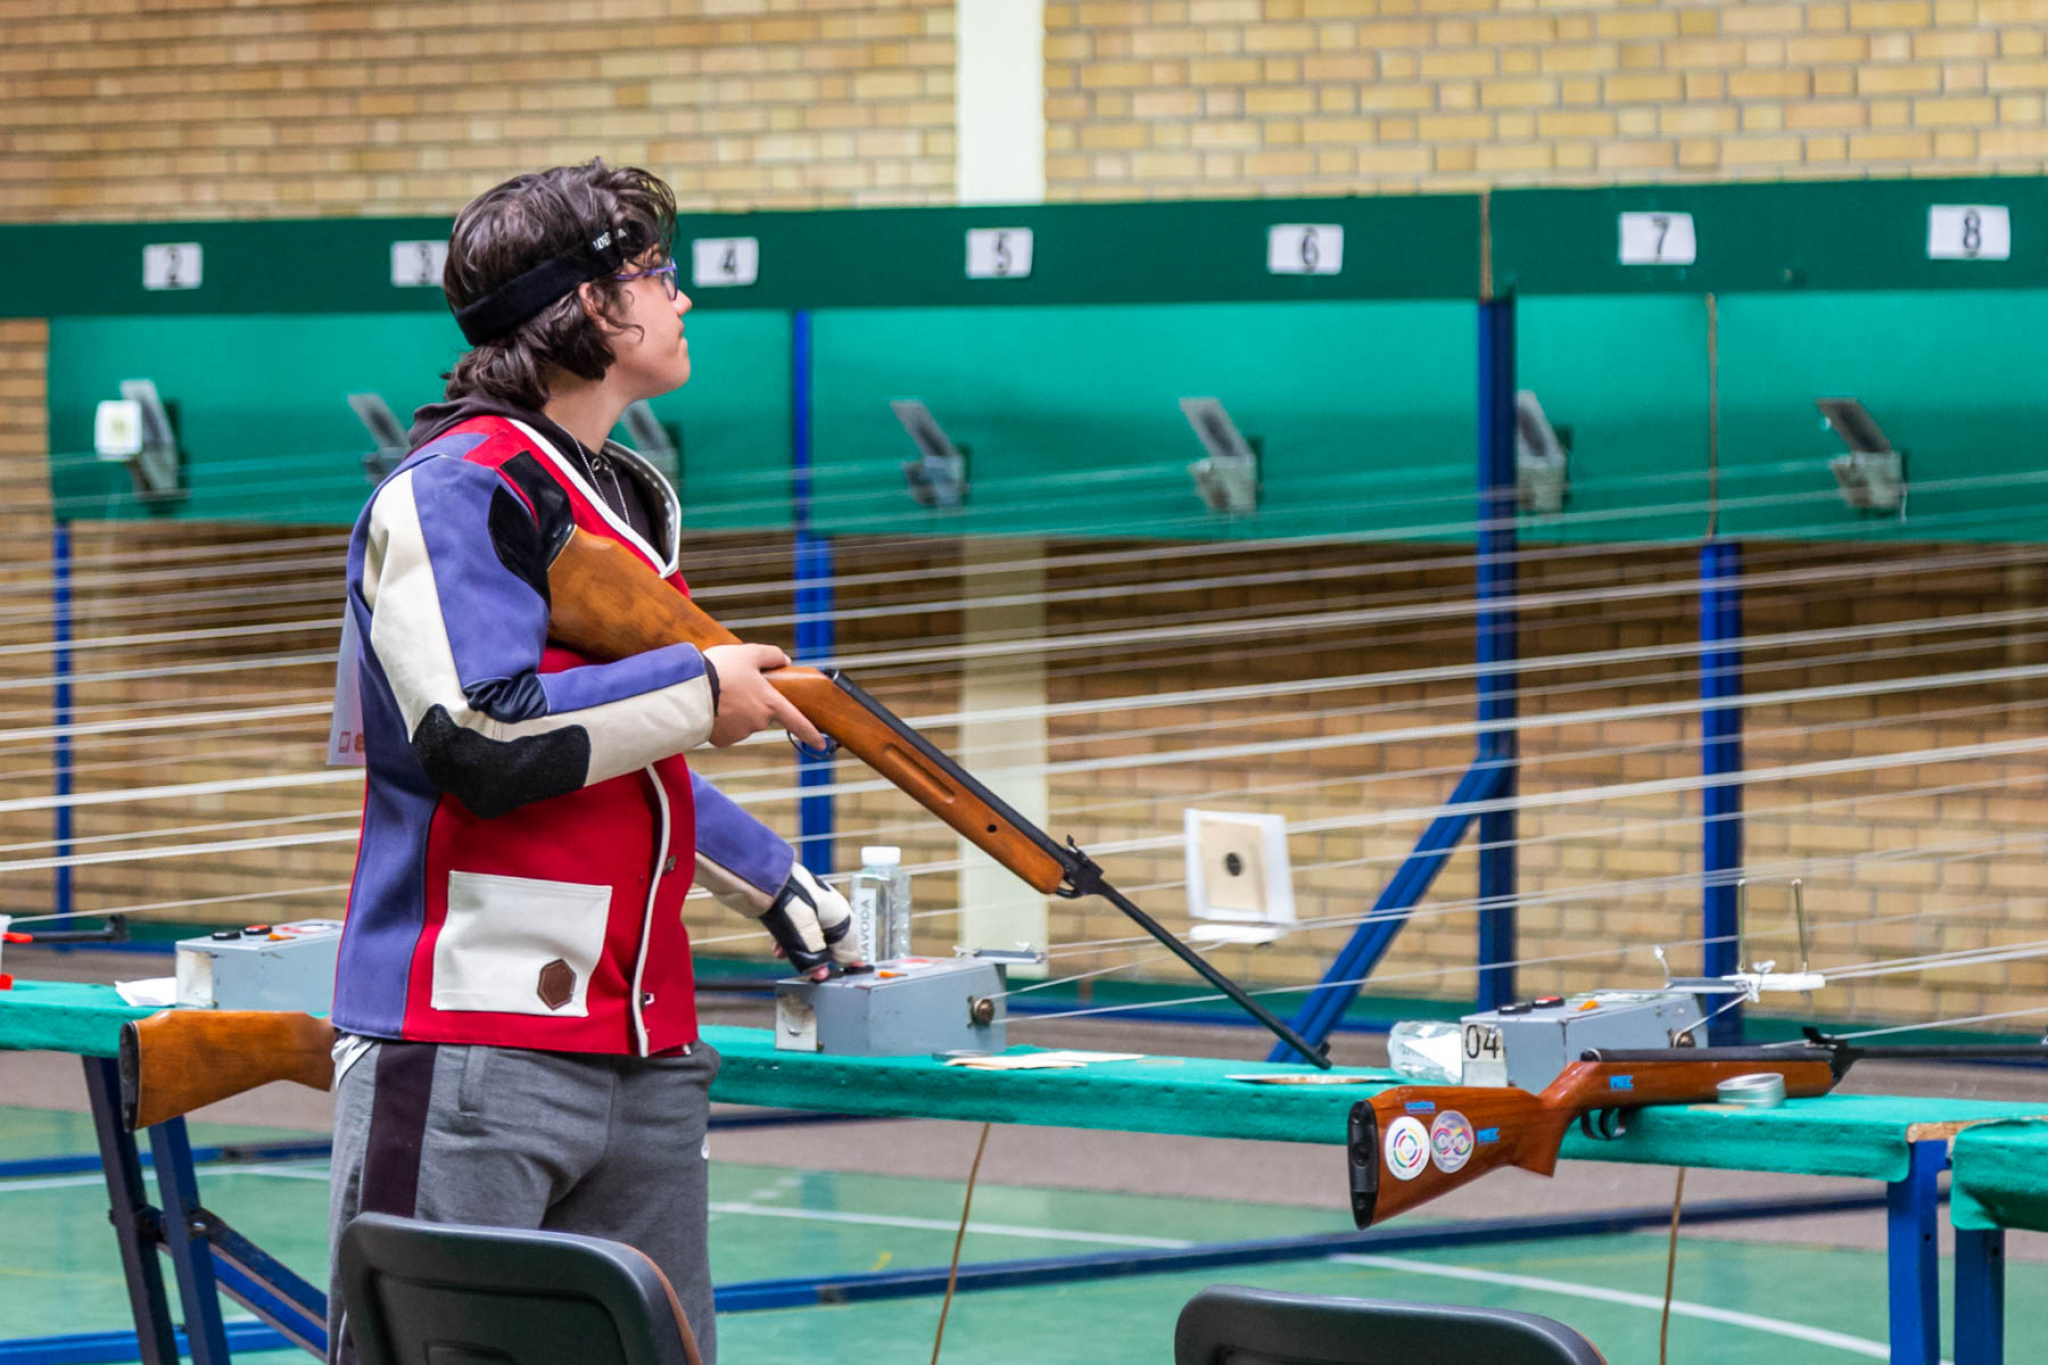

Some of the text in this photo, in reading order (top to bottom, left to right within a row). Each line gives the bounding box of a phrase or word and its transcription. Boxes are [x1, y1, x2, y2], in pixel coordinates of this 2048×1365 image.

[992, 231, 1012, 277] 5
[1300, 226, 1320, 274] 6
[1651, 214, 1671, 263] 7
[1963, 208, 1982, 257] 8
[165, 245, 183, 289] 2
[415, 242, 433, 286] 3
[720, 241, 738, 284] 4
[1465, 1024, 1500, 1059] 04
